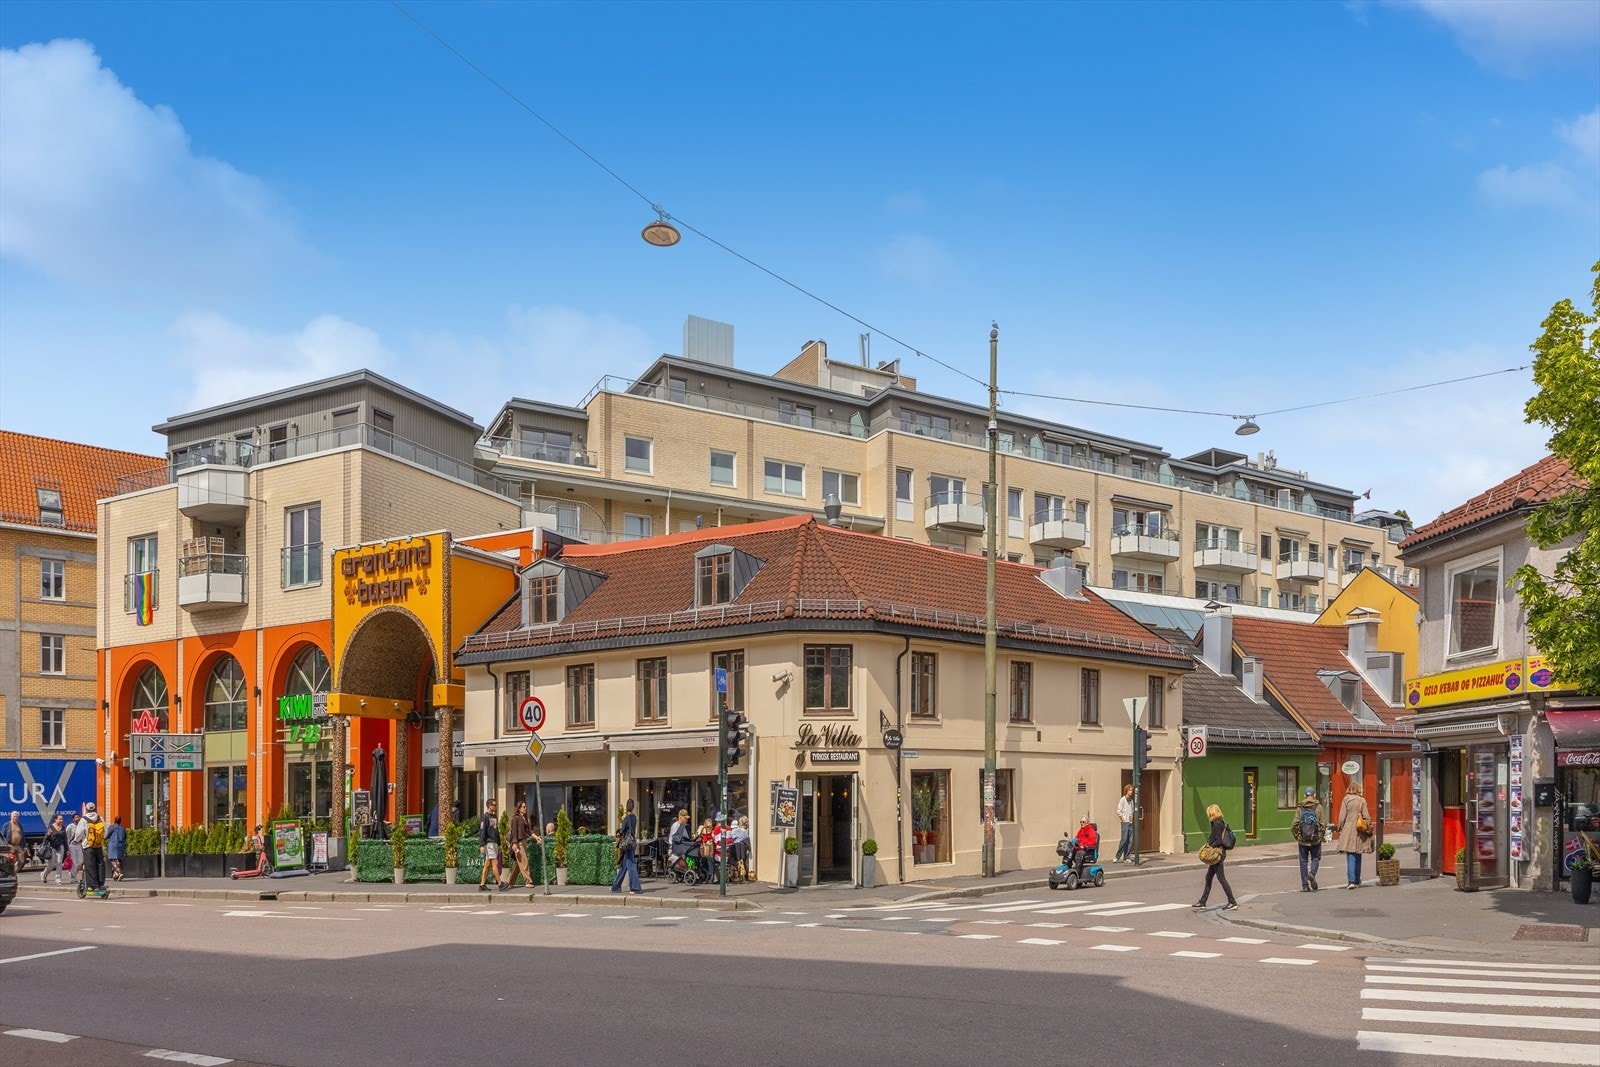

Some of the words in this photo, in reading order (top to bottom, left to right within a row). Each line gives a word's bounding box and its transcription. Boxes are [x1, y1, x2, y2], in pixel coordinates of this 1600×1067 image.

[1424, 685, 1438, 697] OSLO
[1440, 681, 1460, 695] KEBAB
[1461, 679, 1470, 691] OG
[1471, 673, 1505, 689] PIZZAHUS
[279, 694, 313, 720] KIWI
[525, 705, 541, 722] 40
[133, 709, 159, 734] MAX
[289, 724, 321, 744] 7-23
[795, 723, 820, 747] La
[821, 722, 862, 746] Villa
[812, 753, 830, 761] TYRKISK
[830, 752, 859, 761] RESTAURANT
[1193, 741, 1201, 750] 30
